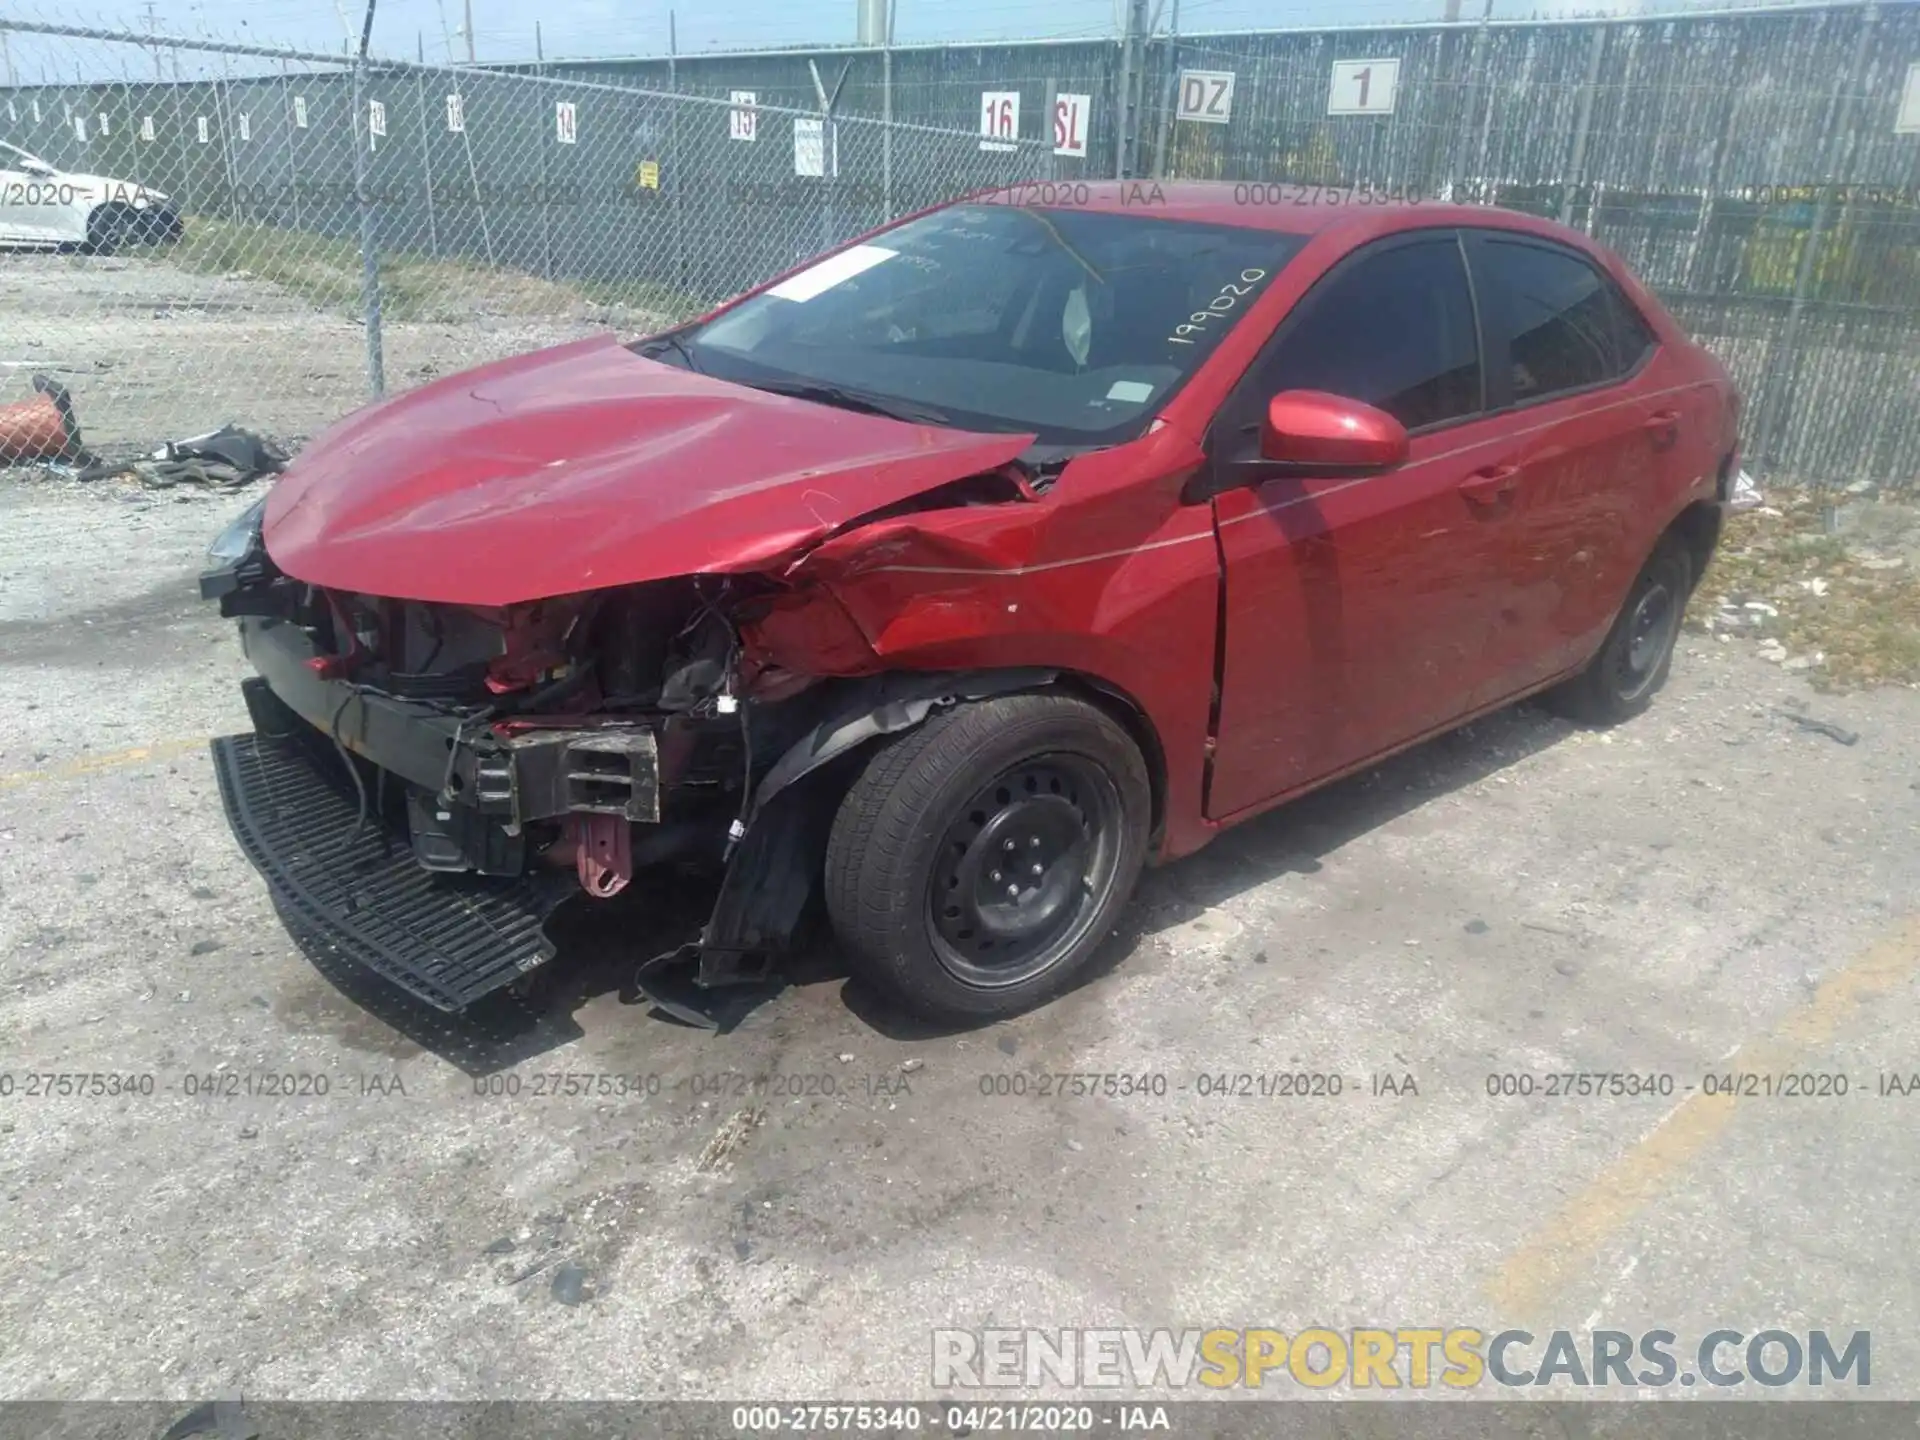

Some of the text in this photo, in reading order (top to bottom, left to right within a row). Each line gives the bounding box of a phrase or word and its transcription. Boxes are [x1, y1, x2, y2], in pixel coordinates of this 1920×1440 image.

[1184, 78, 1228, 115] DZ
[1352, 67, 1371, 107] 1
[986, 99, 1013, 138] 16
[1054, 101, 1082, 150] SL
[1168, 268, 1266, 345] 199020
